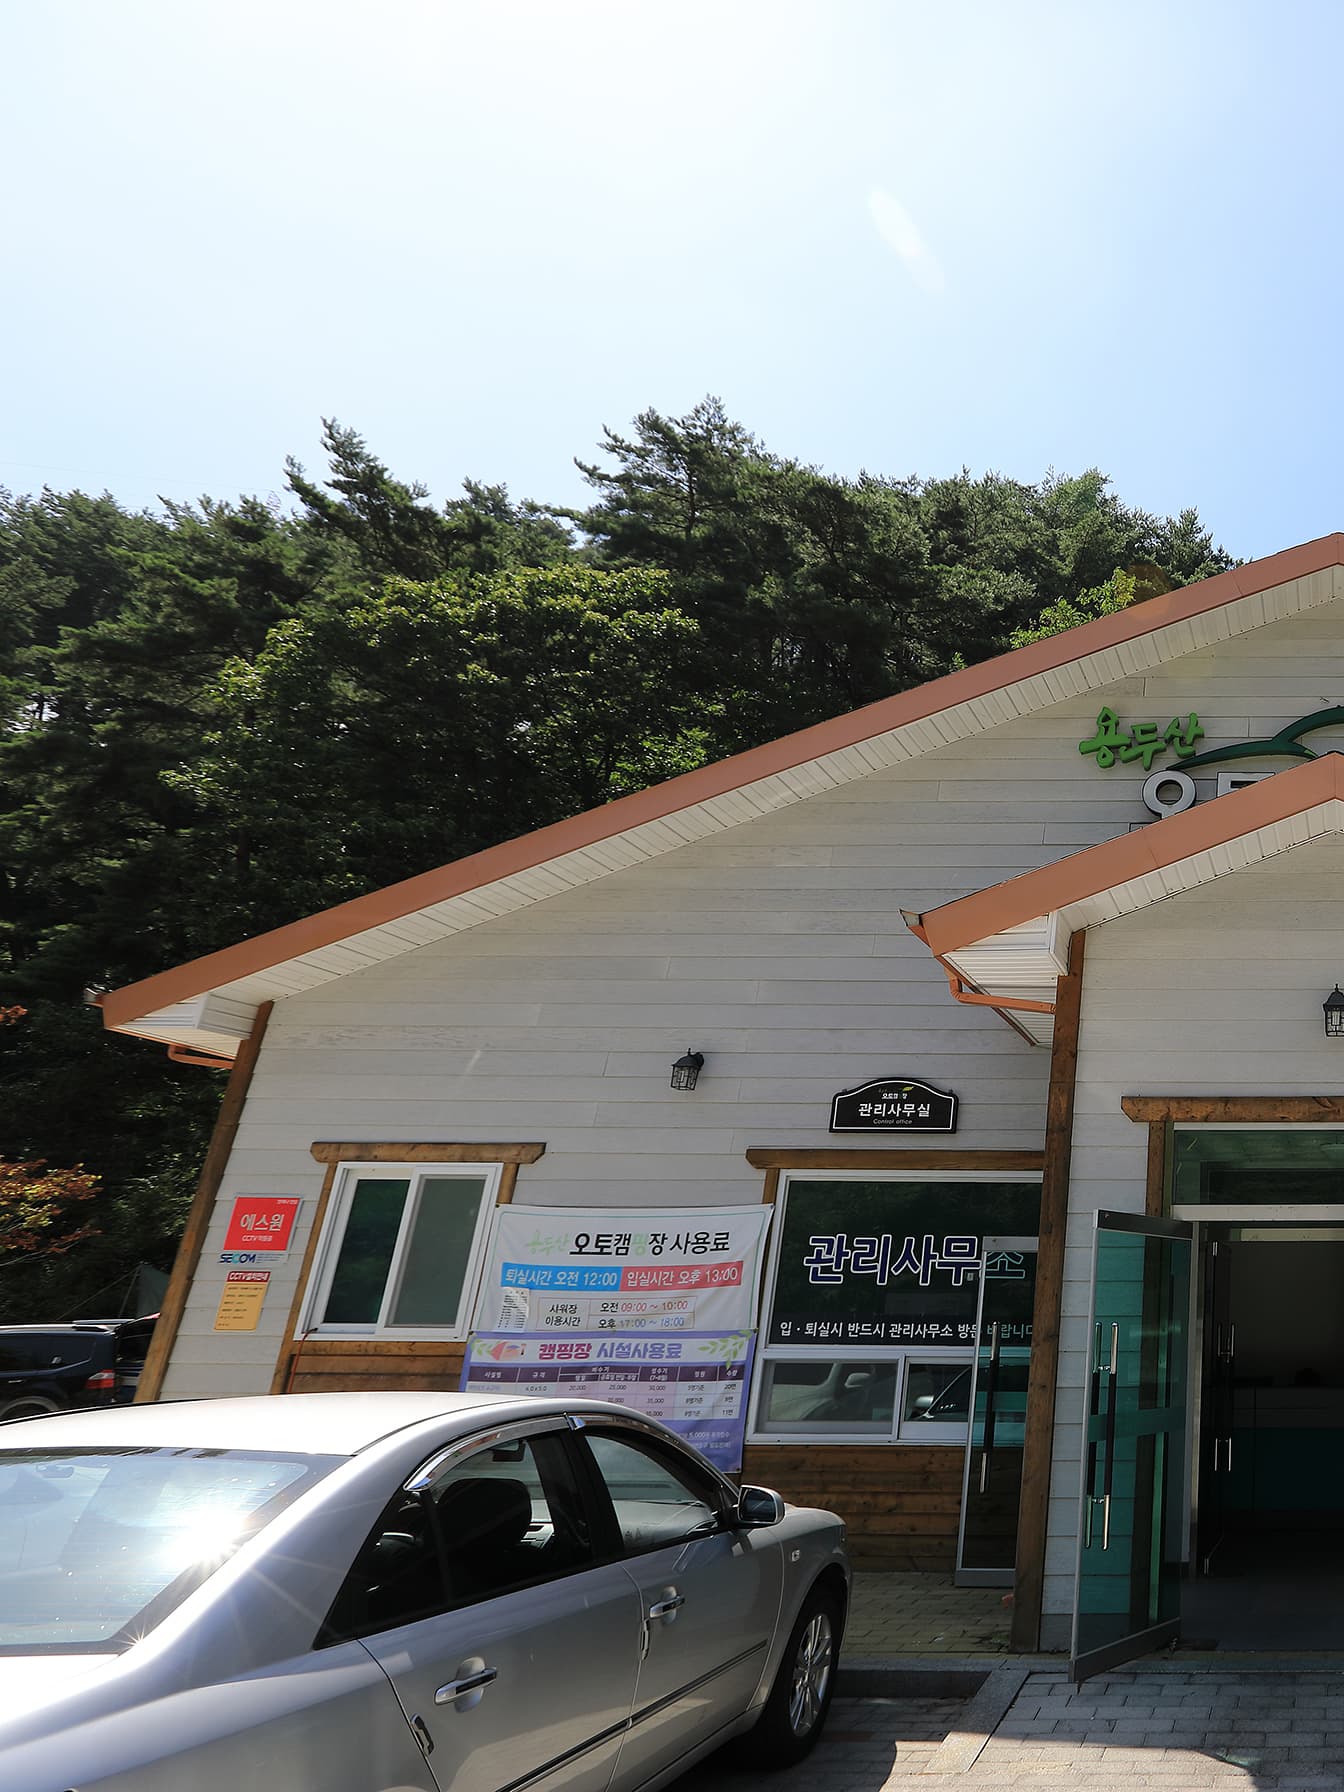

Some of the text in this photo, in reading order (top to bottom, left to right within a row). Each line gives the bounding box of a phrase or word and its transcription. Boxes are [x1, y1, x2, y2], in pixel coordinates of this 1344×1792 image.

[1079, 706, 1205, 772] 용두산
[858, 1103, 931, 1117] 관리사무실
[240, 1213, 285, 1231] 에스원
[669, 1231, 730, 1255] 사용료
[219, 1253, 257, 1263] SECOM
[803, 1234, 1026, 1286] 관리사무소
[505, 1267, 738, 1286] 퇴실시간 오전 12:00 입실시간 오후 13:00
[600, 1302, 619, 1312] 오전
[621, 1302, 647, 1312] 09:00
[662, 1301, 688, 1310] 10:00
[545, 1315, 581, 1327] 이용시간
[598, 1318, 616, 1328] 오후
[847, 1322, 886, 1338] 반드시
[889, 1323, 953, 1339] 관리사무소
[538, 1342, 682, 1361] 캠핑장 시설사용료
